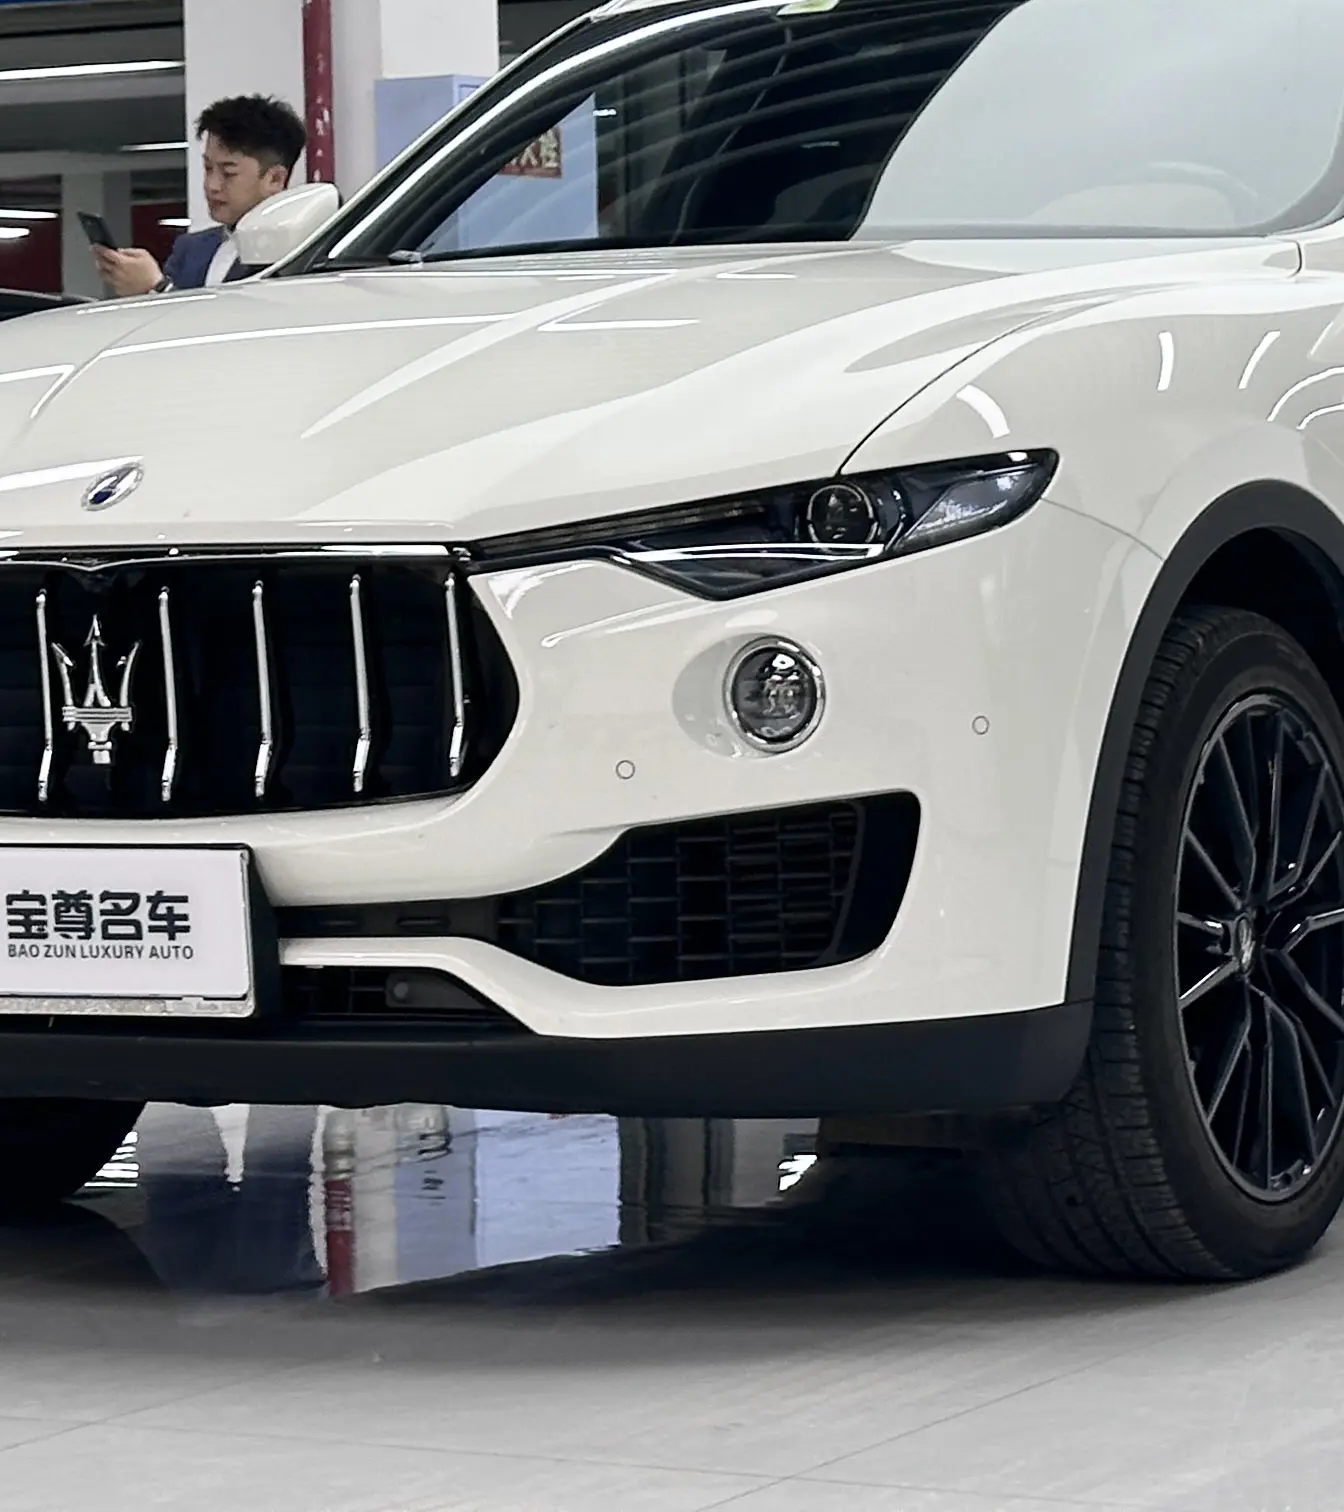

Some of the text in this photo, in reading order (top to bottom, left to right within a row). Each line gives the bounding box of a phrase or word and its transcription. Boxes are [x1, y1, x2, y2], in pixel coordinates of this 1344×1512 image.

[6, 889, 192, 941] 宝尊名车
[8, 944, 194, 960] BAO ZUN LUXURY AUTO
